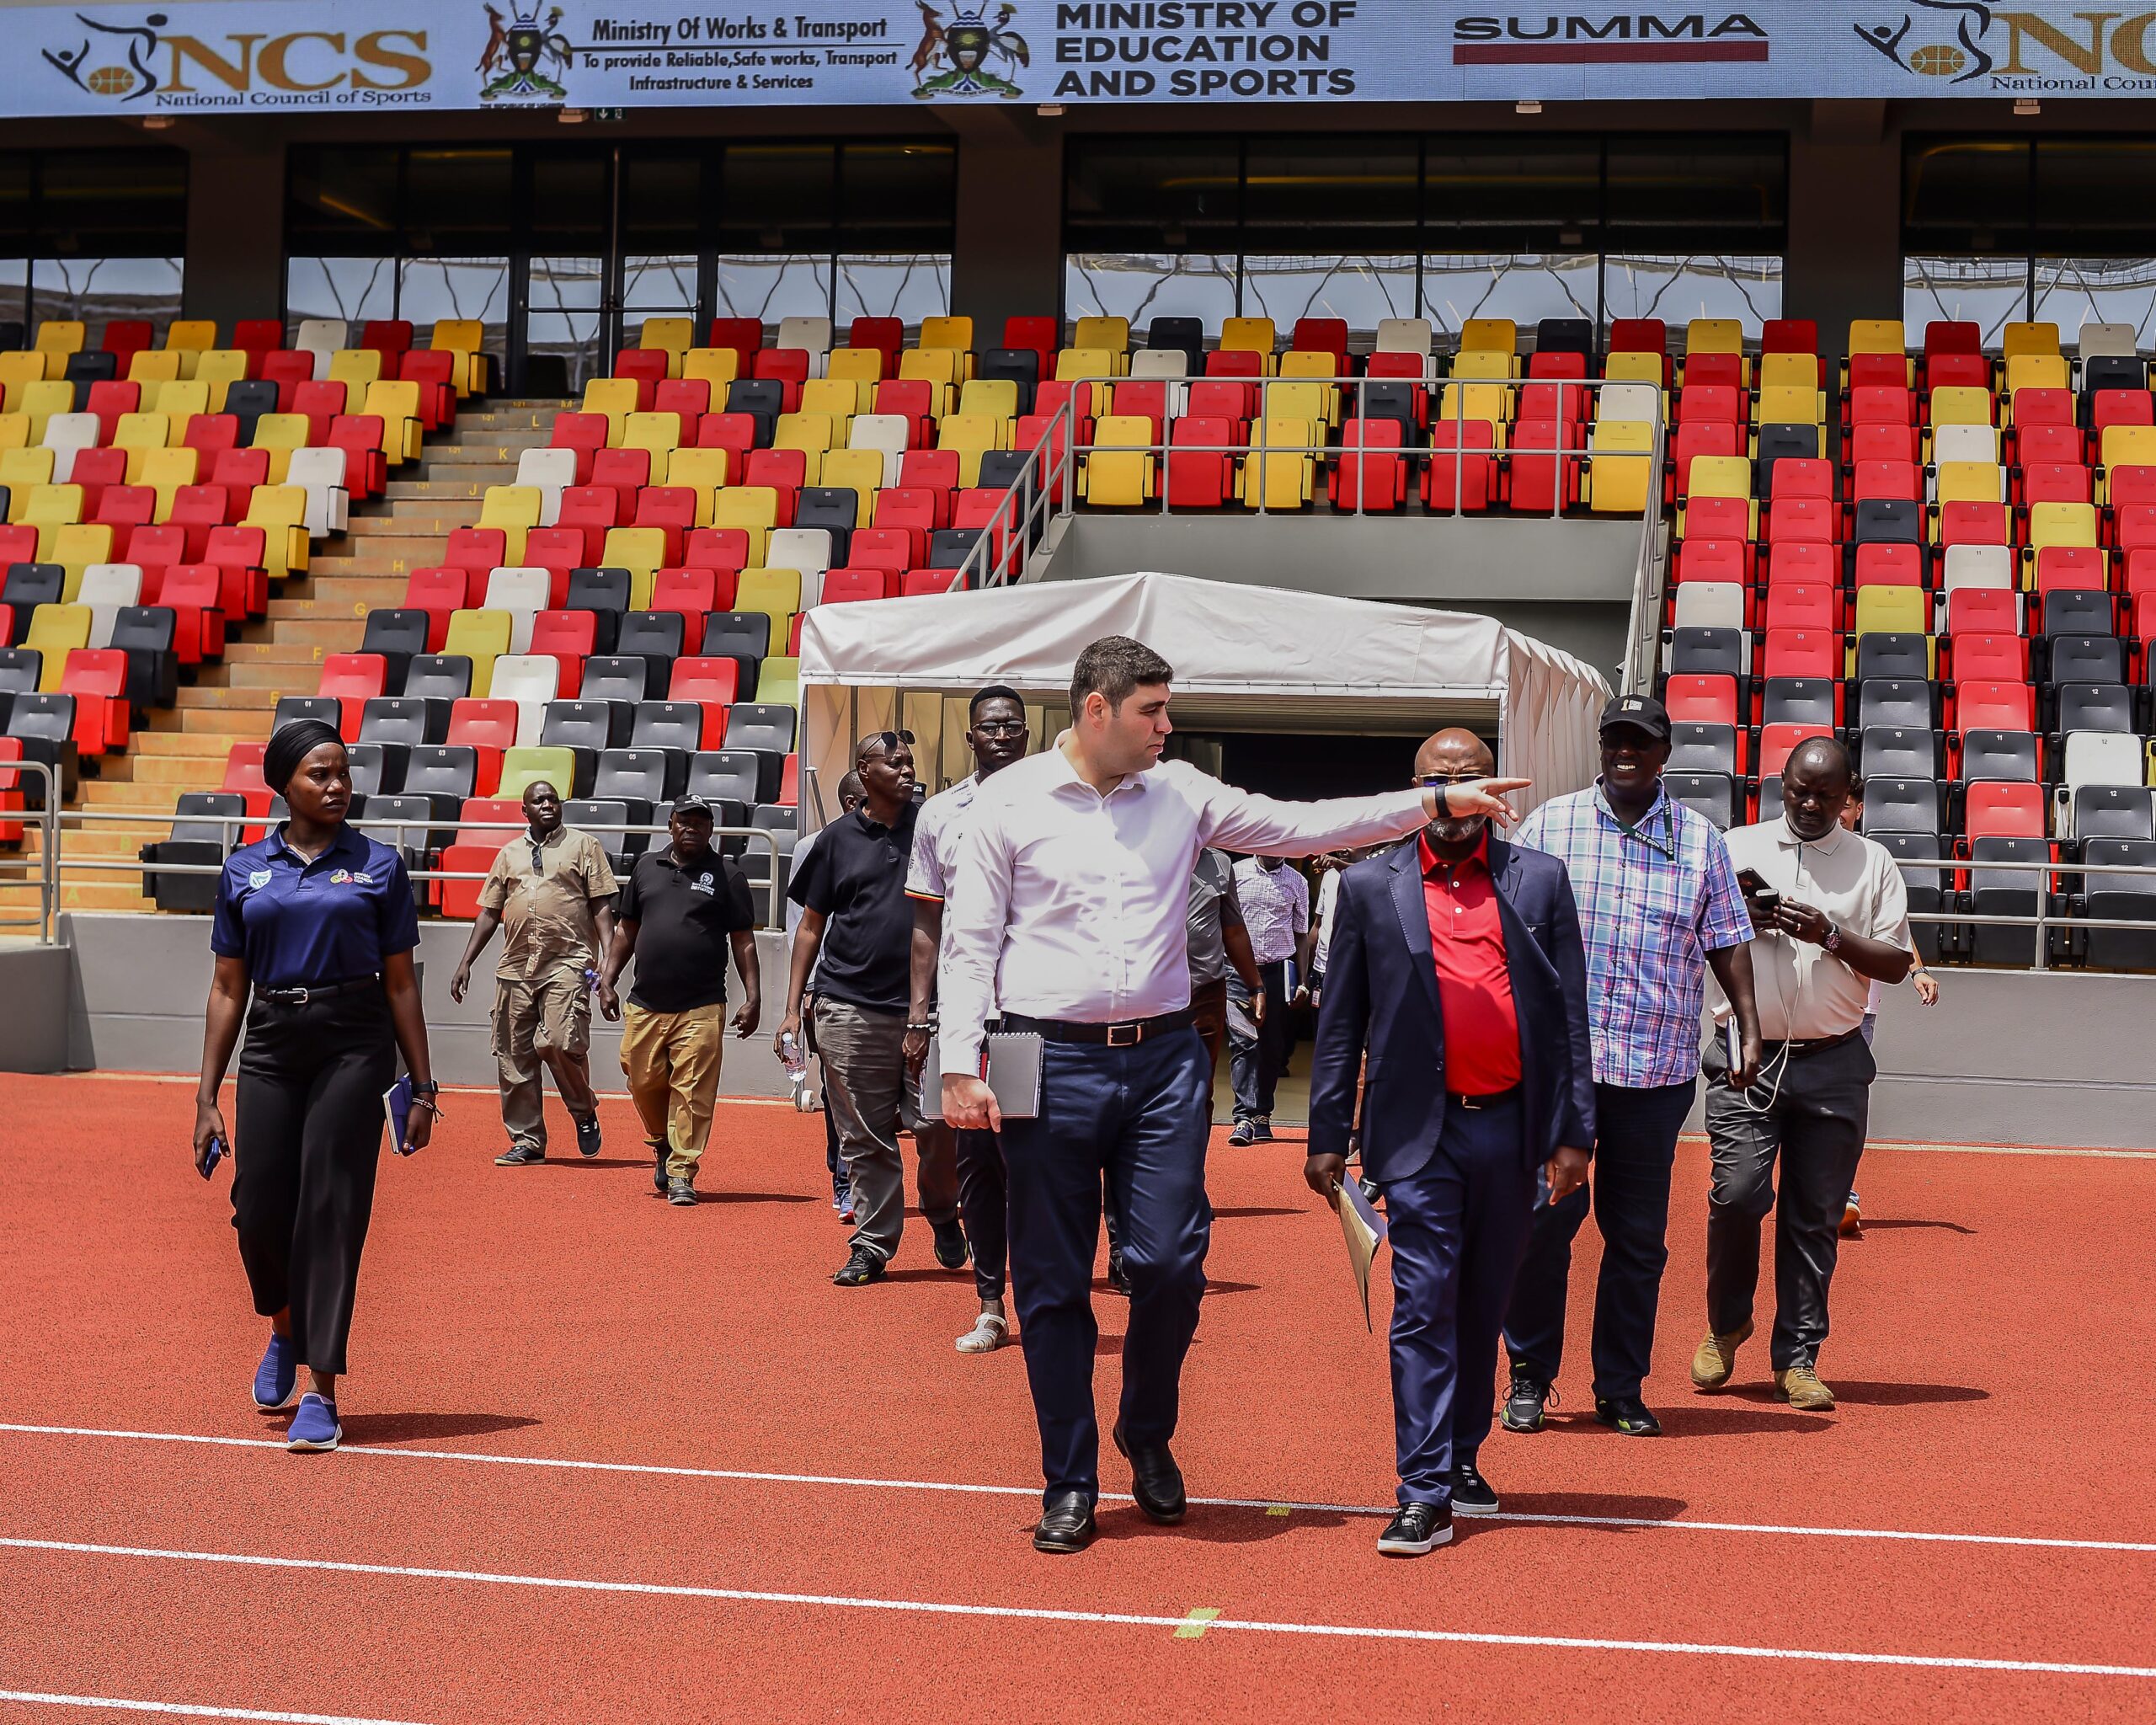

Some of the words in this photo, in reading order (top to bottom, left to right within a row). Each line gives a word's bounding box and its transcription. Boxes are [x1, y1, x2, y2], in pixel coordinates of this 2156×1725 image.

[1057, 2, 1278, 29] MINISTRY
[1292, 1, 1355, 28] OF
[593, 19, 671, 45] Ministry
[677, 17, 701, 39] Of
[706, 16, 766, 39] Works
[773, 17, 787, 38] &
[795, 16, 887, 43] Transport
[1454, 14, 1769, 40] SUMMA
[1056, 35, 1329, 62] EDUCATION
[157, 30, 431, 93] NCS
[584, 53, 599, 69] To
[604, 52, 661, 71] provide
[771, 51, 821, 67] works,
[825, 50, 897, 68] Transport
[630, 76, 731, 90] Infrastructure
[737, 74, 748, 88] &
[752, 74, 814, 88] Services
[1054, 71, 1155, 96] AND
[1169, 68, 1355, 96] SPORTS
[1990, 76, 2095, 89] National
[156, 93, 243, 106] National
[250, 91, 330, 105] Council
[336, 90, 360, 104] of
[362, 90, 431, 106] Sports
[532, 415, 539, 427] L
[499, 448, 508, 460] K
[468, 484, 477, 495] J
[435, 520, 439, 531] I
[392, 560, 404, 573] H
[354, 603, 366, 616] G
[313, 647, 322, 660] F
